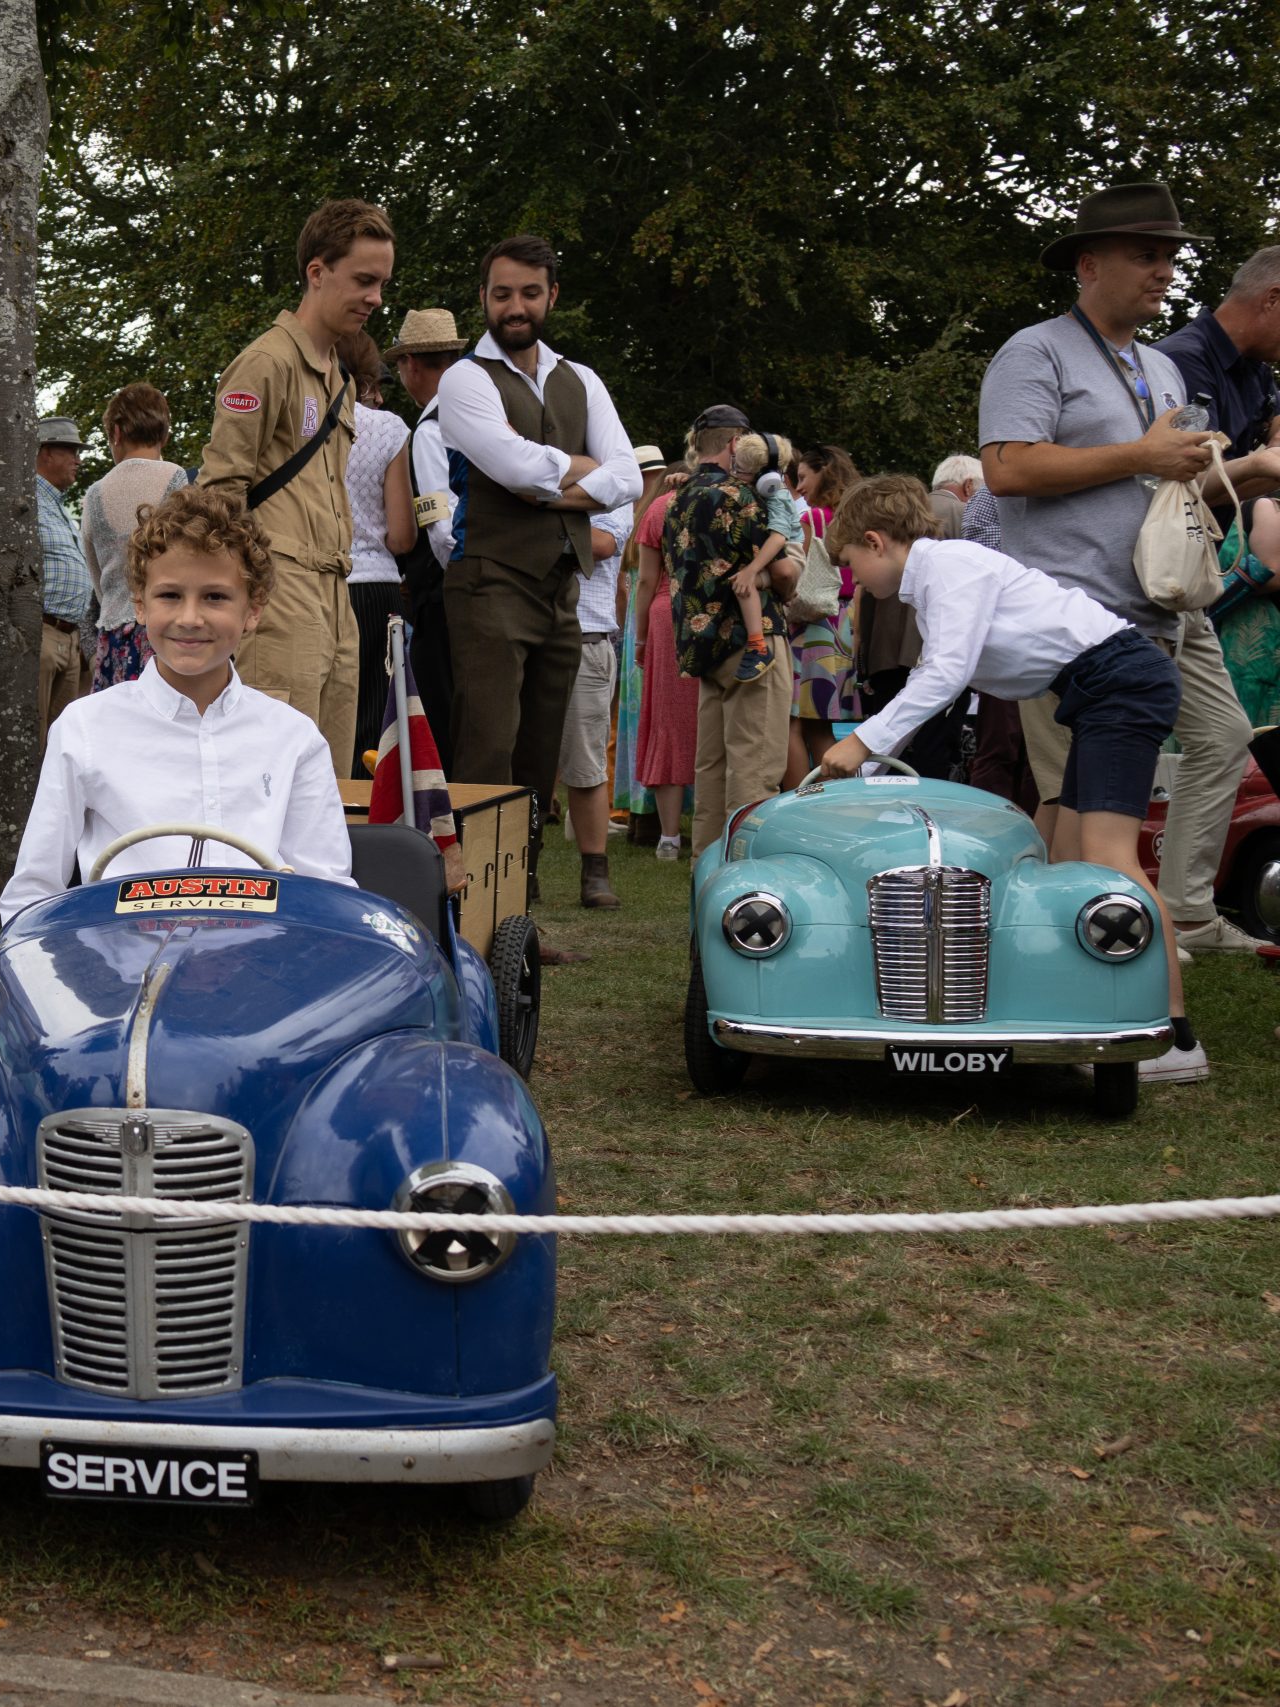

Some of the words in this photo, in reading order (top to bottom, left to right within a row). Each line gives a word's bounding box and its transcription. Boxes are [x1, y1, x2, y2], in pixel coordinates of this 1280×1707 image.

[225, 397, 257, 407] BUGATTI
[125, 877, 271, 898] AUSTIN
[132, 899, 255, 911] SERVICE
[892, 1052, 1008, 1073] WILOBY
[47, 1452, 248, 1498] SERVICE
